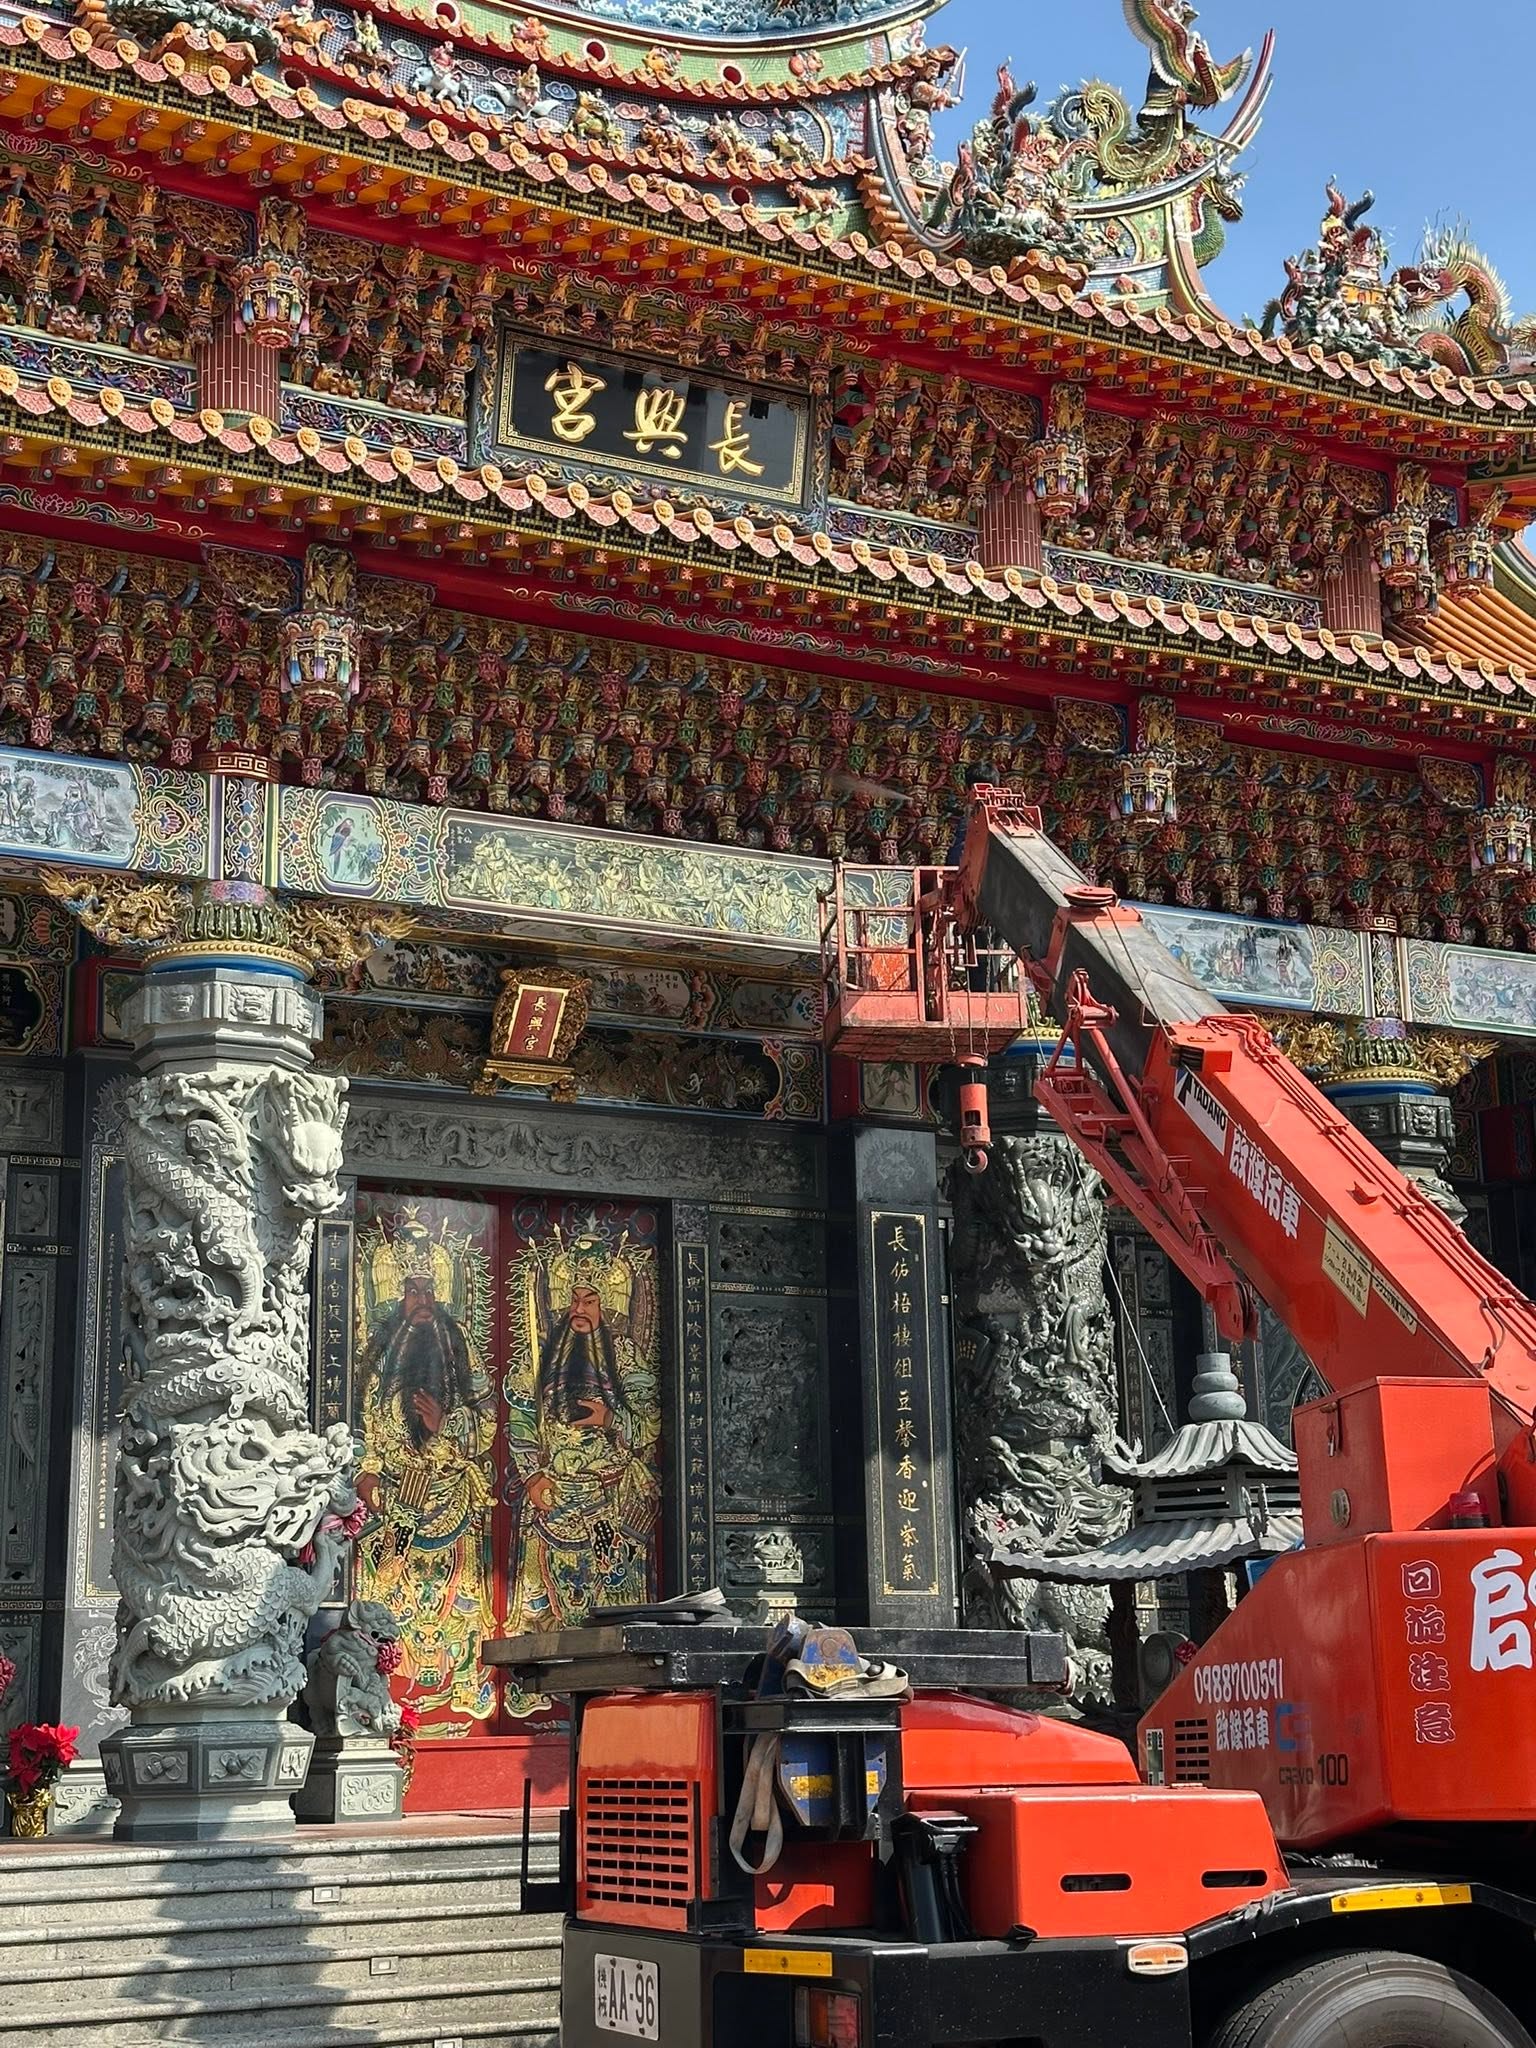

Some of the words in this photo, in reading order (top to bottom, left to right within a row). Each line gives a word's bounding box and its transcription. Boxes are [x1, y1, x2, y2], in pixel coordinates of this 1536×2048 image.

[545, 361, 765, 477] 長興宮
[524, 995, 547, 1051] 長興宮
[1192, 1077, 1227, 1132] TADANO
[1400, 1559, 1456, 1744] 回旋注意
[1193, 1657, 1284, 1704] 0988700591
[1279, 1766, 1314, 1785] CREVO
[1317, 1752, 1349, 1787] 100
[608, 1966, 655, 2028] AA-96
